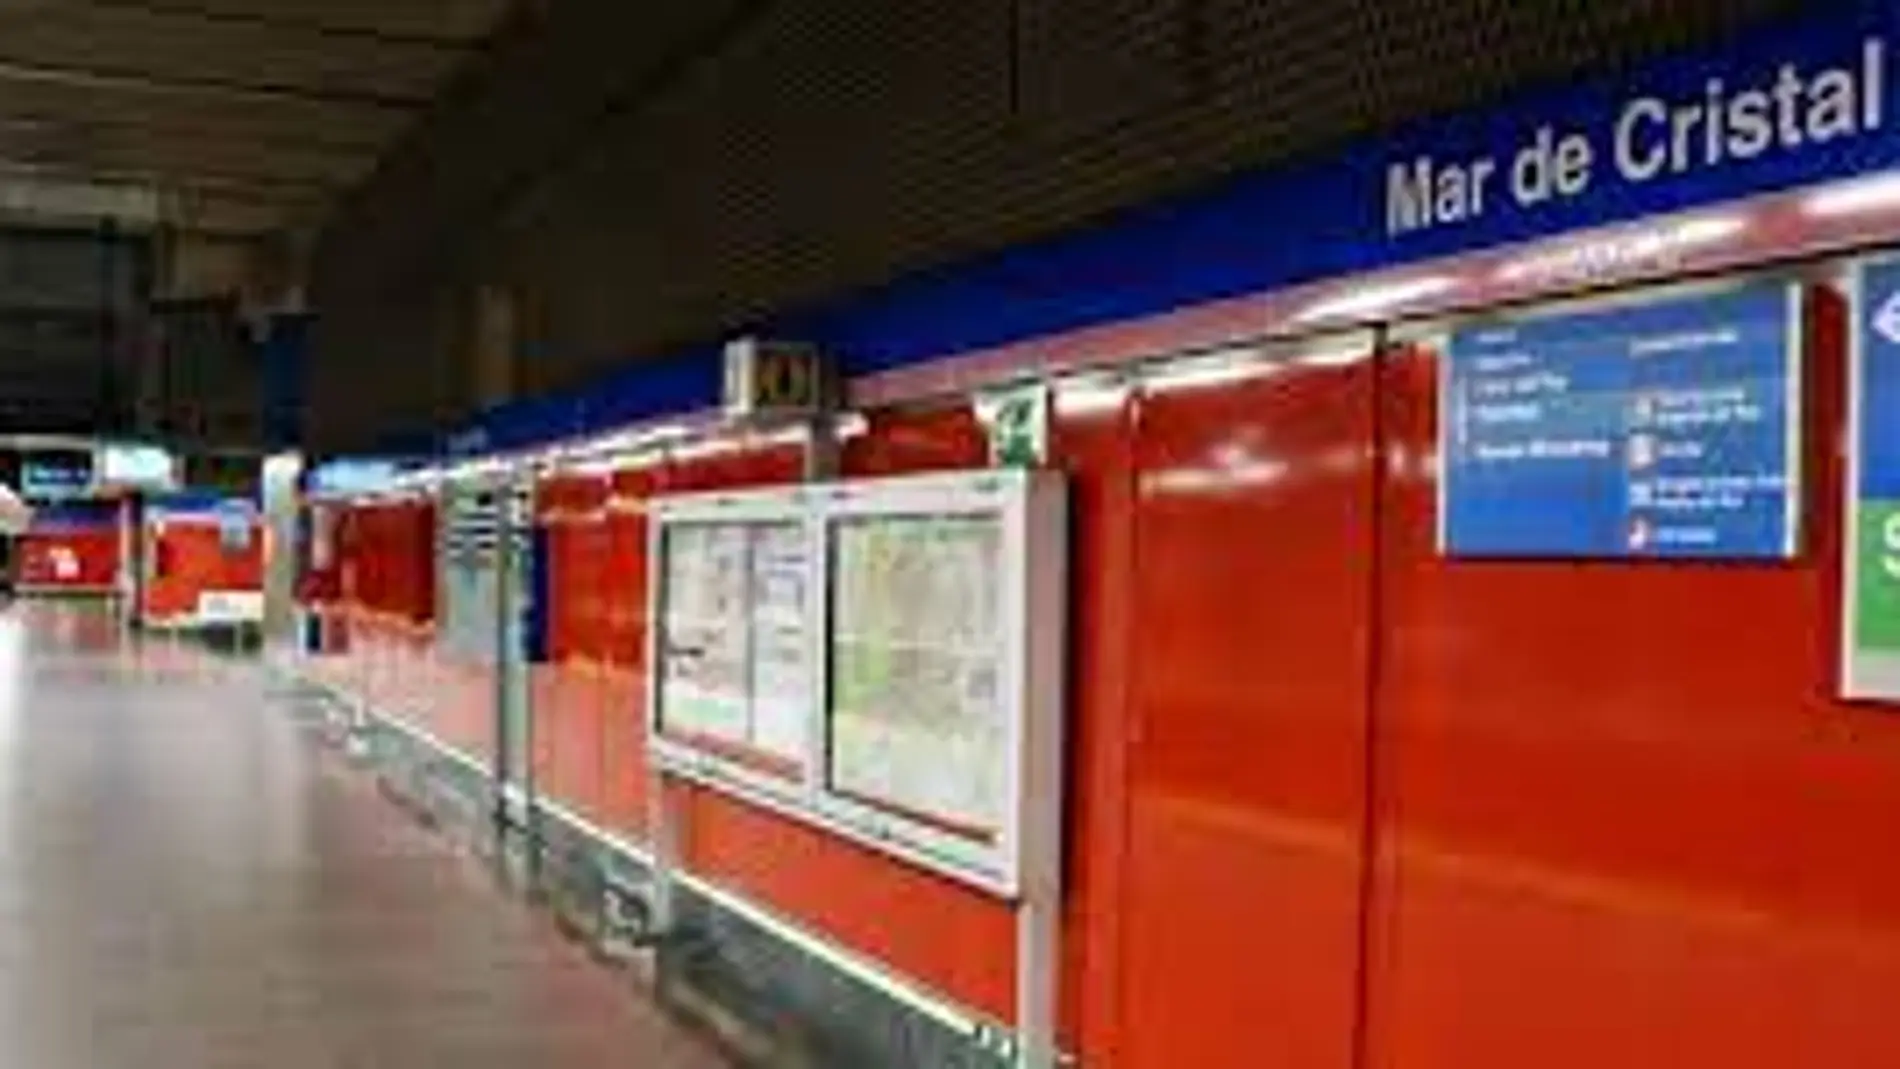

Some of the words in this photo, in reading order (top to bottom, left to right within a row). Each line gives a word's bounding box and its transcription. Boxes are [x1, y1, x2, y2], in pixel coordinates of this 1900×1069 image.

[1386, 158, 1495, 235] Mar
[1511, 127, 1593, 205] de
[1614, 39, 1883, 181] Cristal
